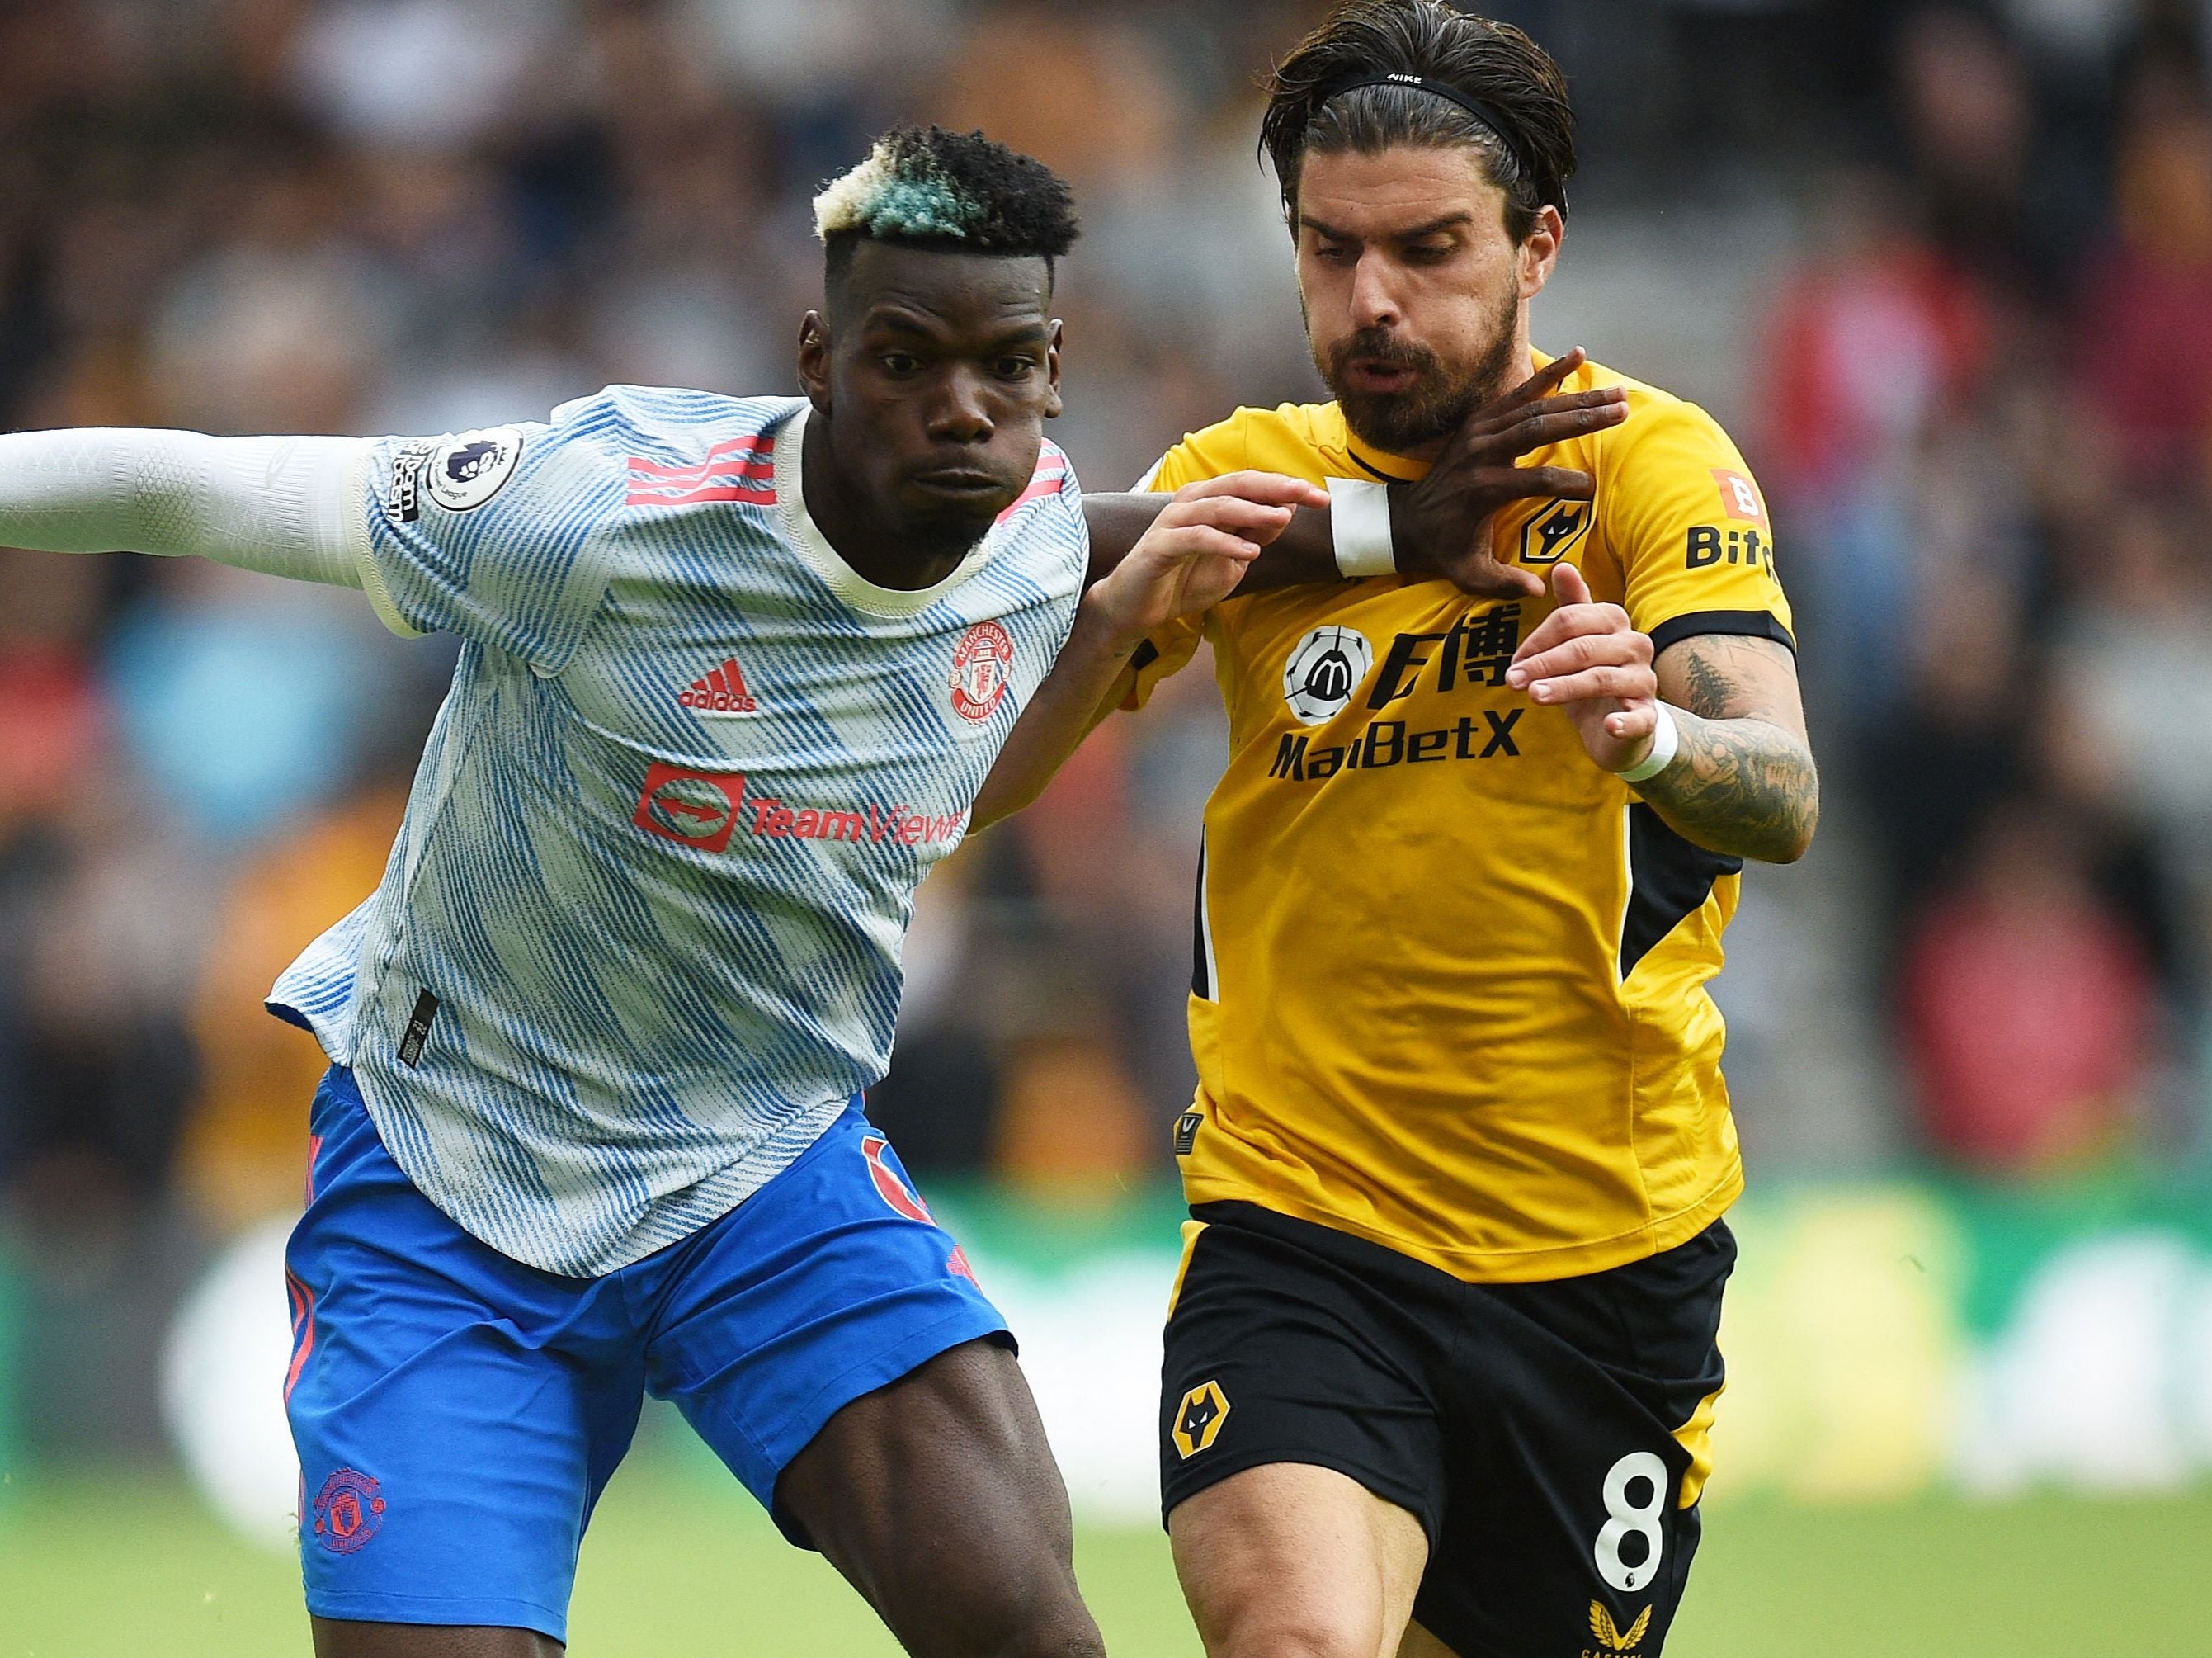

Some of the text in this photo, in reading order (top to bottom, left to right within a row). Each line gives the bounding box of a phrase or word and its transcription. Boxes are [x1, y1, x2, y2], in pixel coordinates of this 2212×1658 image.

[1387, 73, 1422, 84] NIKE
[957, 624, 1011, 662] MANCHESTER
[677, 688, 757, 713] adidas
[960, 697, 997, 718] UNITED
[1594, 1451, 1668, 1592] 8
